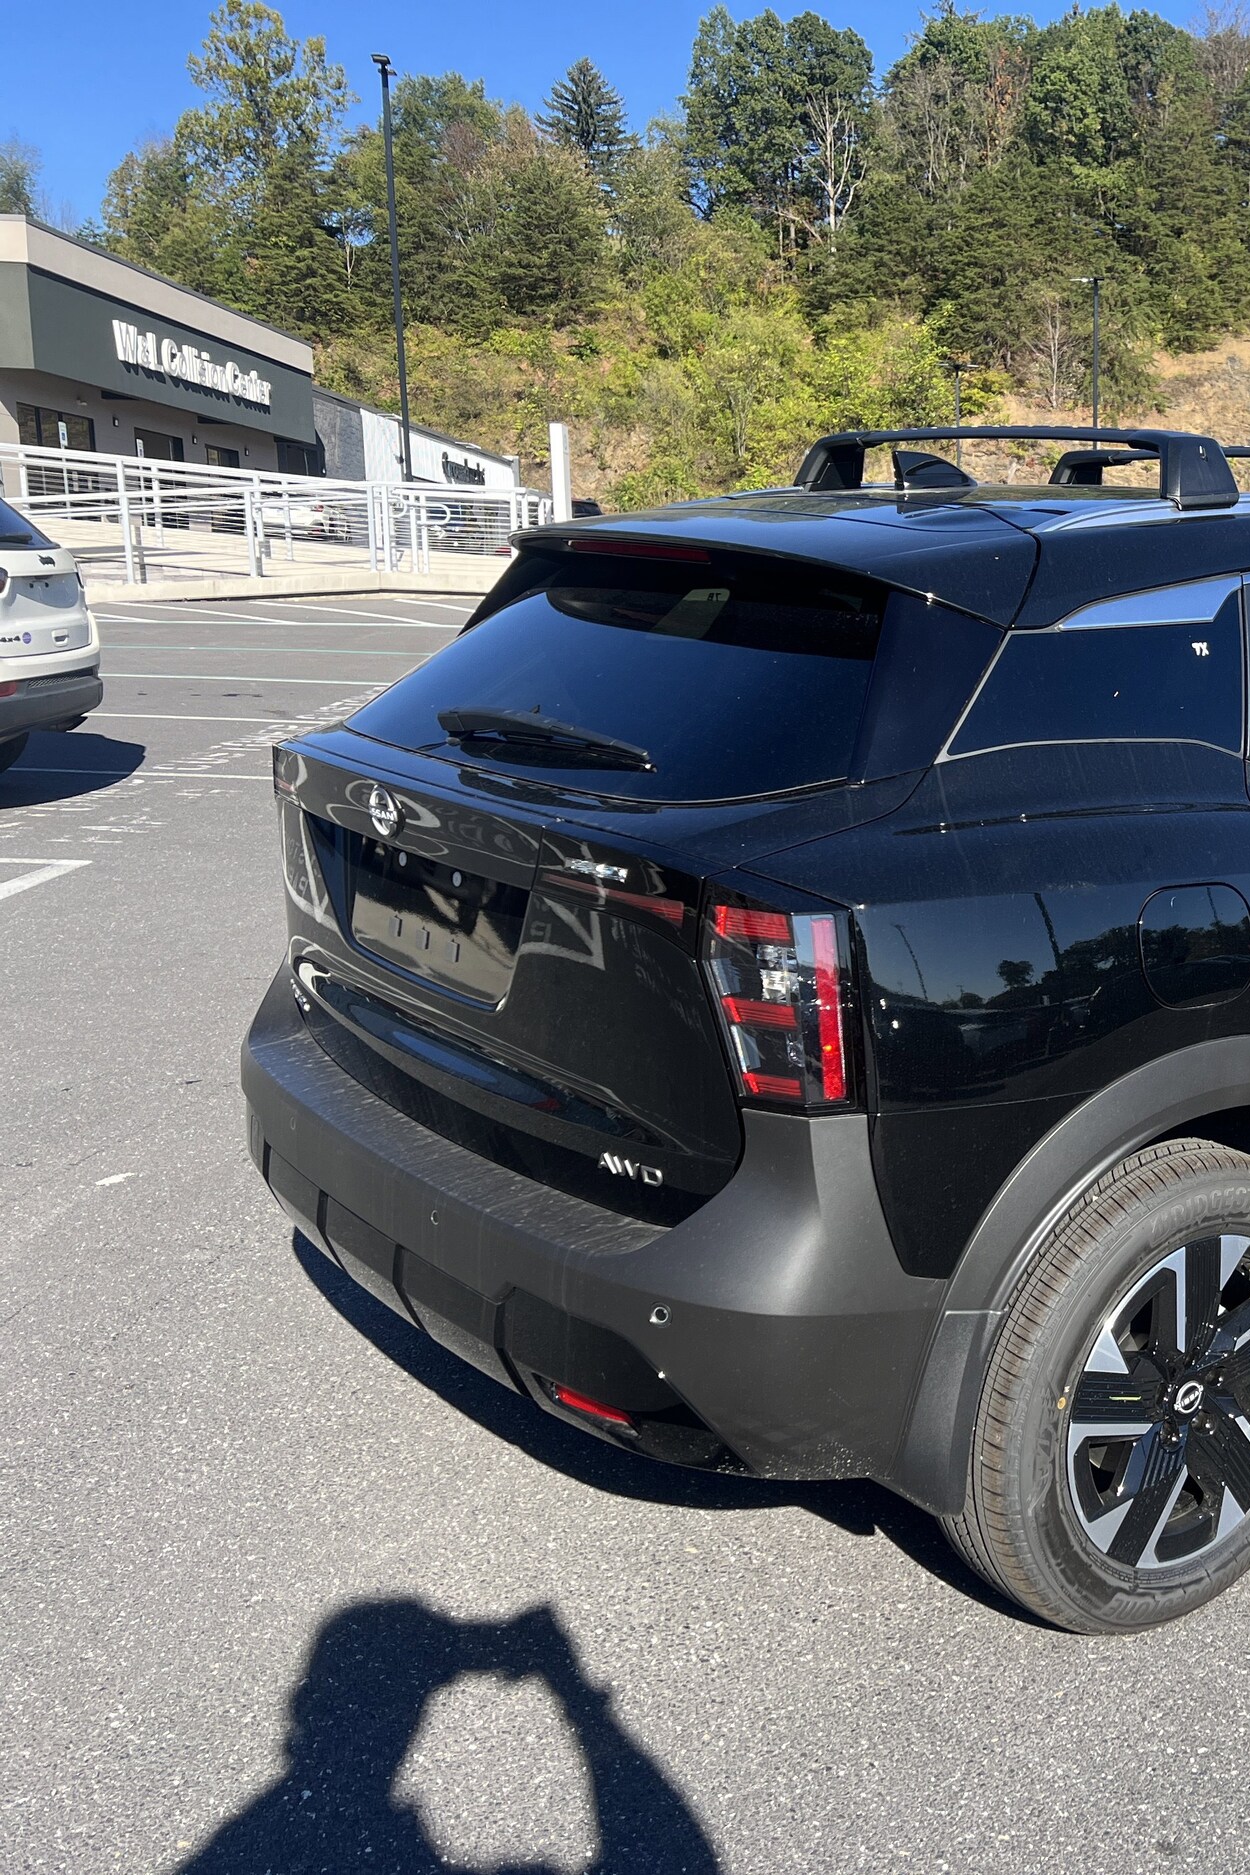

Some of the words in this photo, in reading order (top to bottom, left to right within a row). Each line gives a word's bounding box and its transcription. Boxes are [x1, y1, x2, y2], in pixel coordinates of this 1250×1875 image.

[111, 319, 165, 374] W&L
[161, 338, 230, 394] Collision
[225, 361, 272, 406] Center
[598, 1151, 664, 1188] AWD
